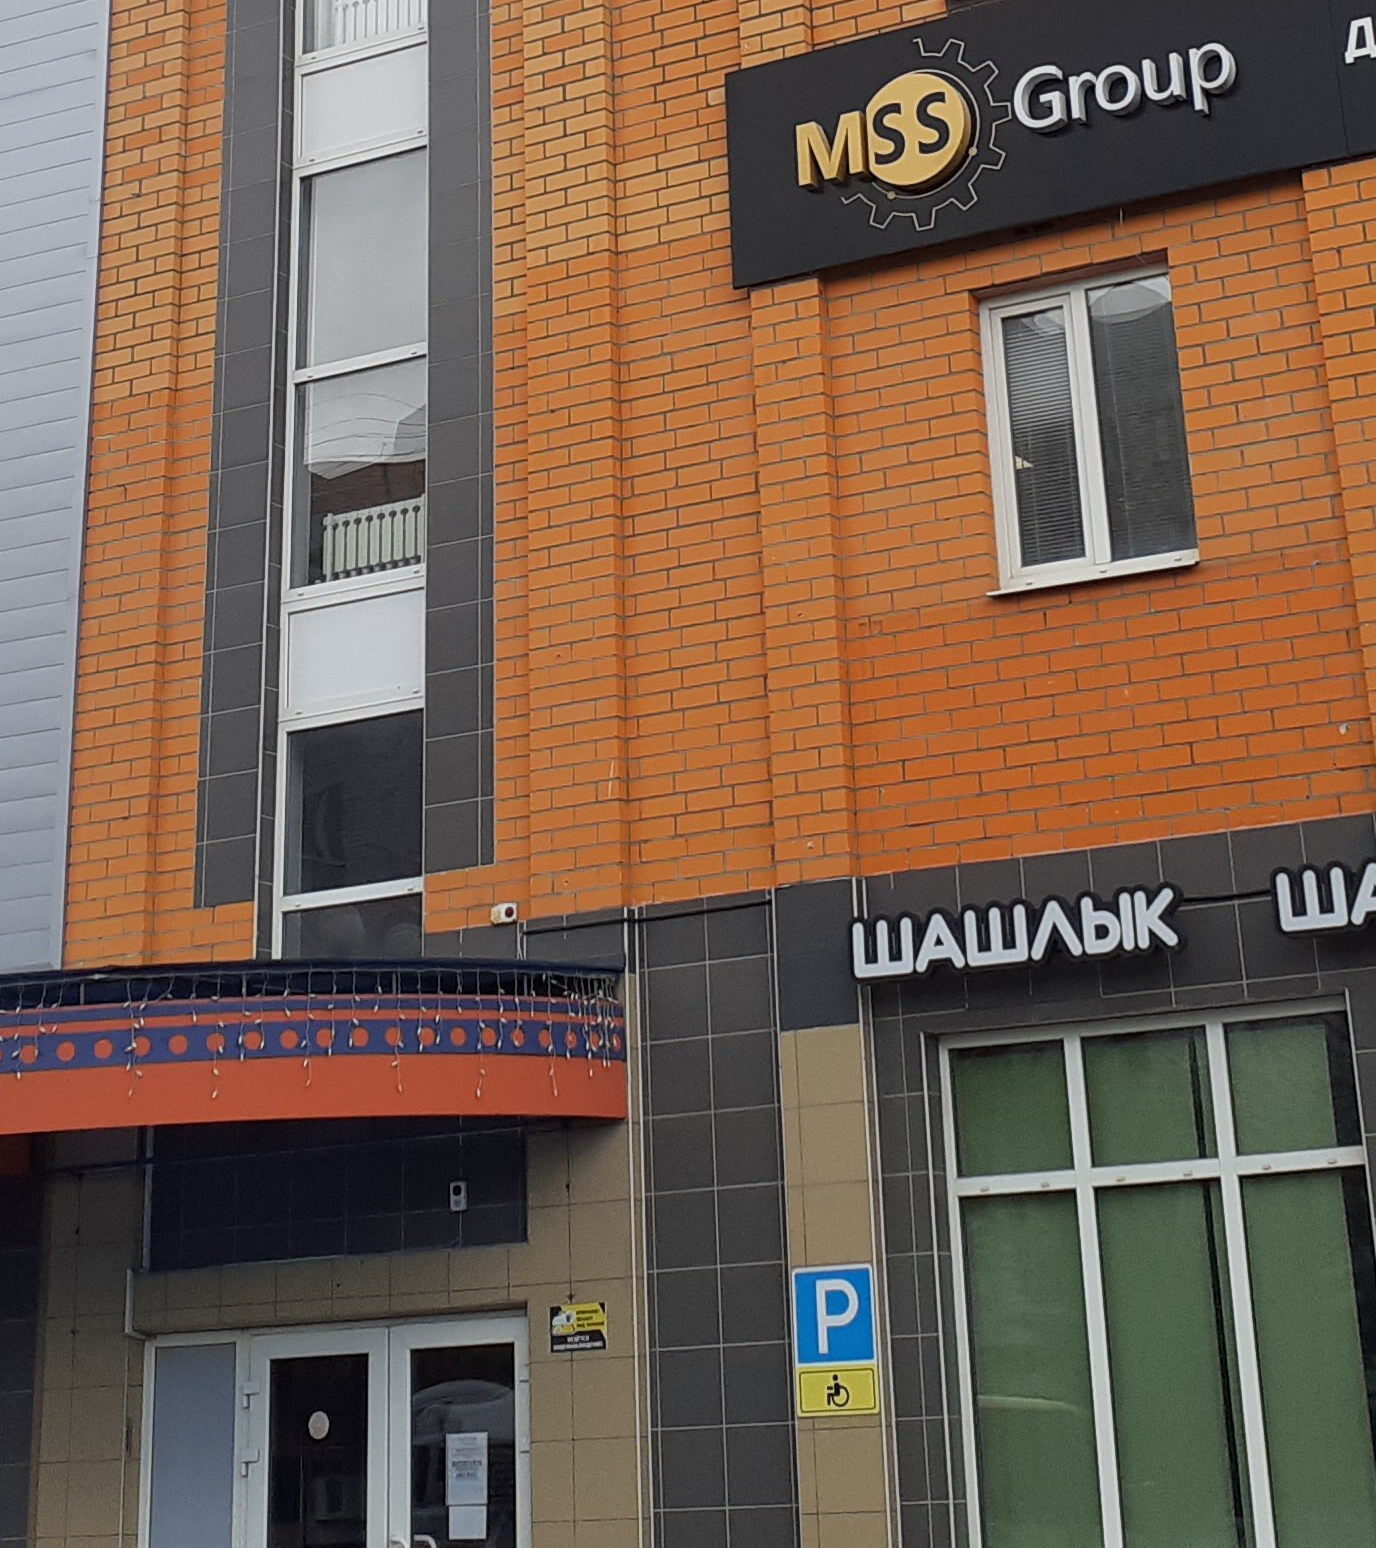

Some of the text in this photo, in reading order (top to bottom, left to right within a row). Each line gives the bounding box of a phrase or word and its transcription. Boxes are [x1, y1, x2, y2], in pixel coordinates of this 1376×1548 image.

[795, 42, 1237, 190] MSS Group
[853, 887, 1179, 979] ШАШЛЫК
[816, 1279, 859, 1354] P
